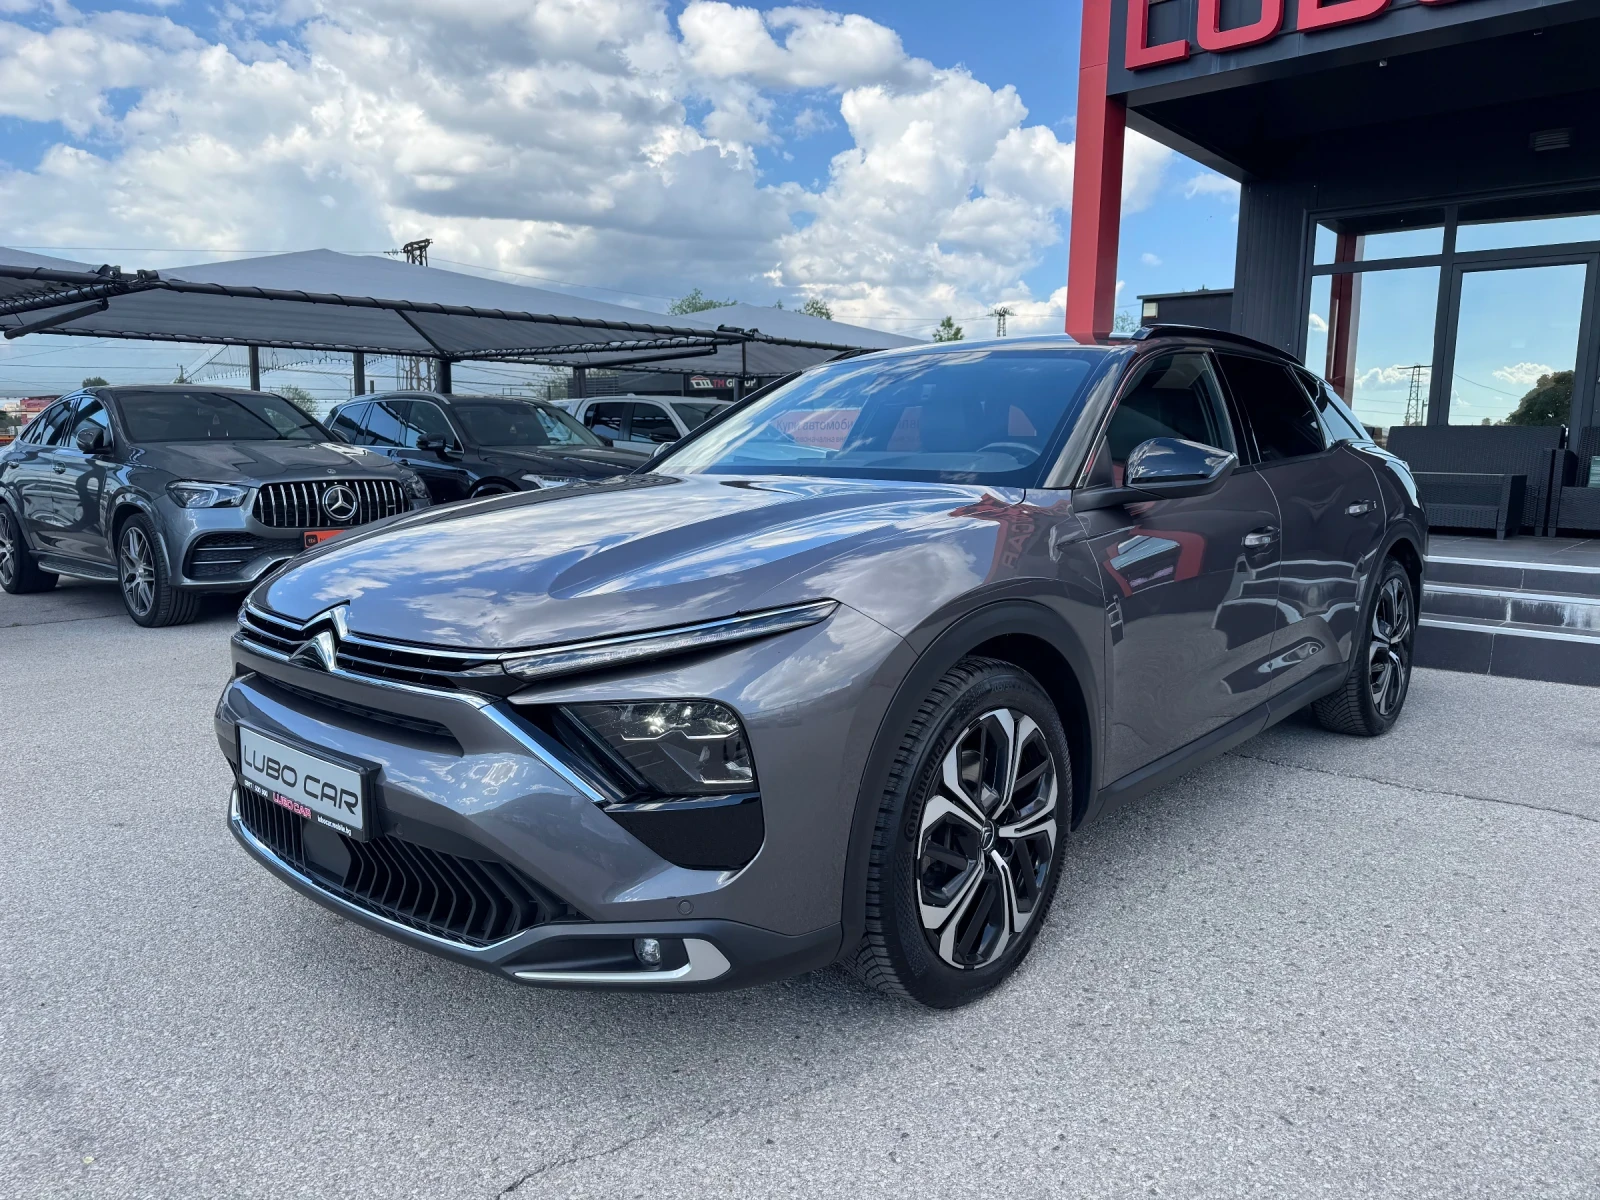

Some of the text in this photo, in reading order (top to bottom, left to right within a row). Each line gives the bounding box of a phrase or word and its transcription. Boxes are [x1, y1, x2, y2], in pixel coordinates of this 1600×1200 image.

[712, 379, 756, 388] TM GUP
[244, 745, 359, 816] LUBO CAR
[903, 734, 947, 843] Continental
